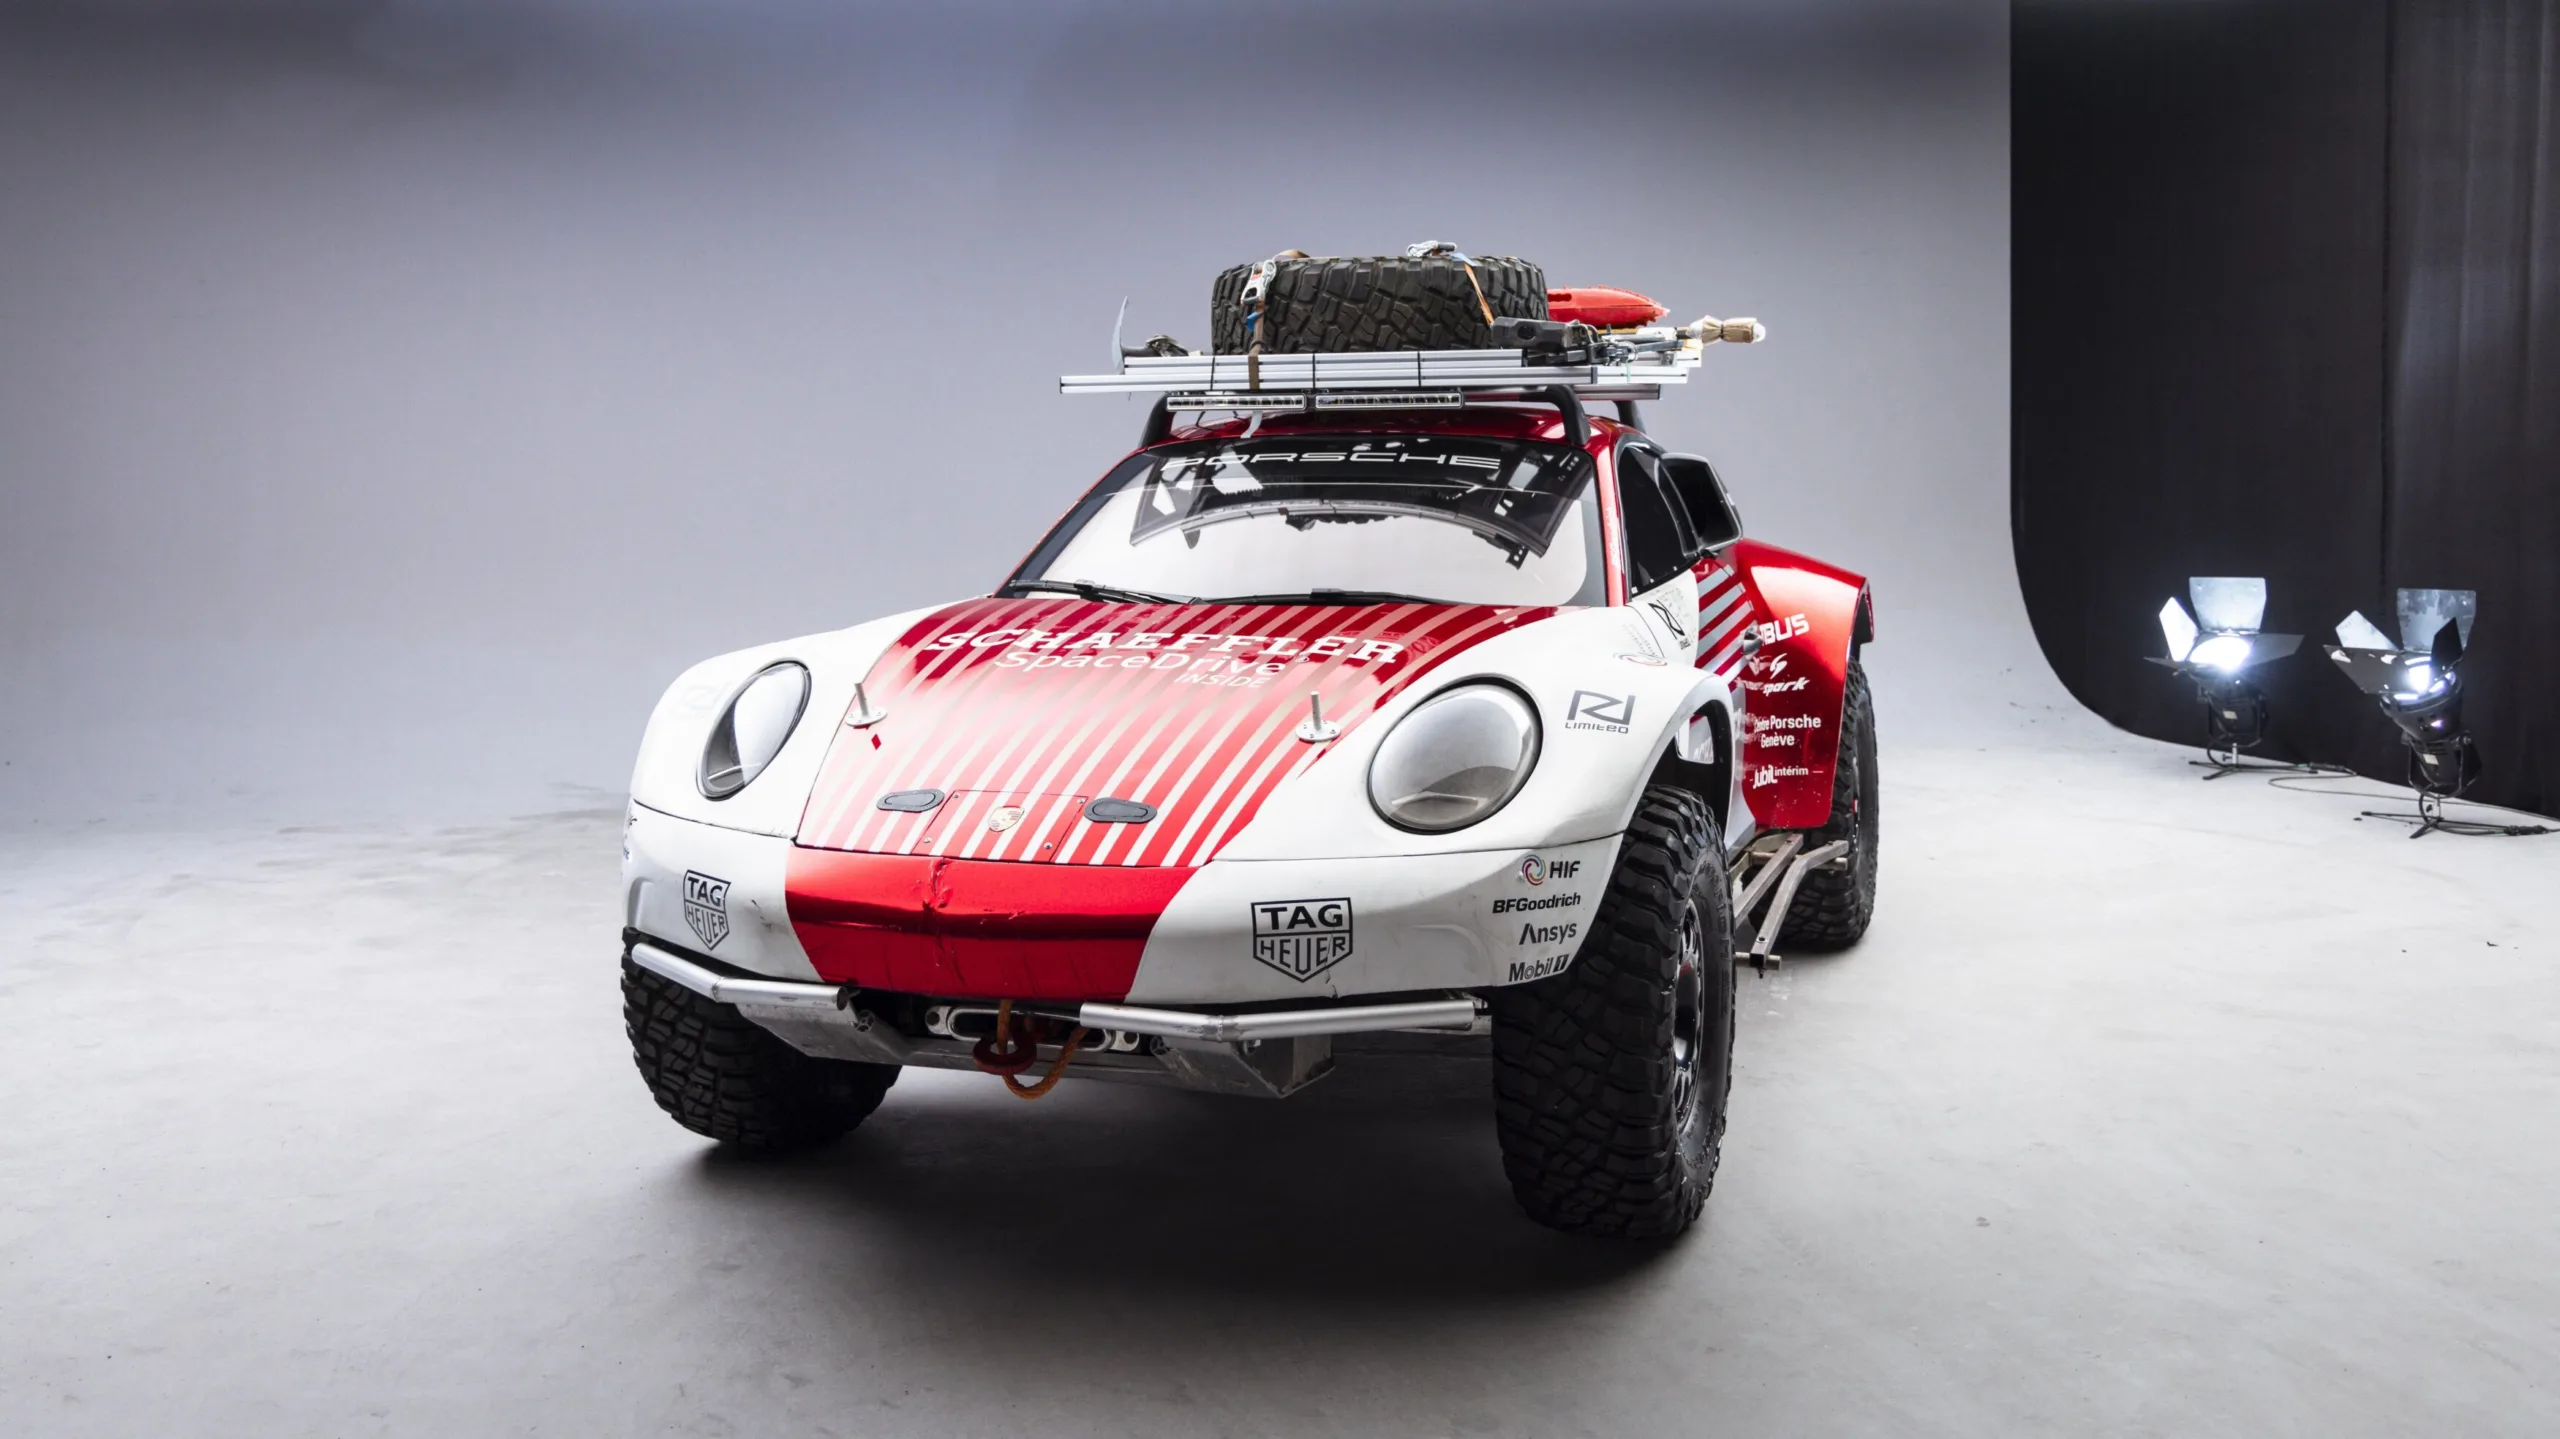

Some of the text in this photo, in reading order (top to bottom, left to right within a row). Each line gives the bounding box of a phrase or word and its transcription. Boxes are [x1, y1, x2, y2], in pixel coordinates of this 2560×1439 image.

[1160, 452, 1501, 470] PORSCHE
[924, 628, 1405, 664] SCHAEFFLER
[1173, 672, 1274, 688] INSIDE
[1770, 713, 1822, 730] Porsche
[1760, 731, 1795, 749] Genève
[1774, 764, 1809, 777] intérim
[1549, 860, 1581, 879] HIF
[687, 875, 723, 907] TAG
[1492, 892, 1581, 914] BFGoodrich
[686, 904, 726, 944] HEUER
[1260, 903, 1344, 931] TAG
[1518, 922, 1577, 945] Ansys
[1260, 936, 1346, 975] HEUER
[1508, 956, 1554, 982] Mobil
